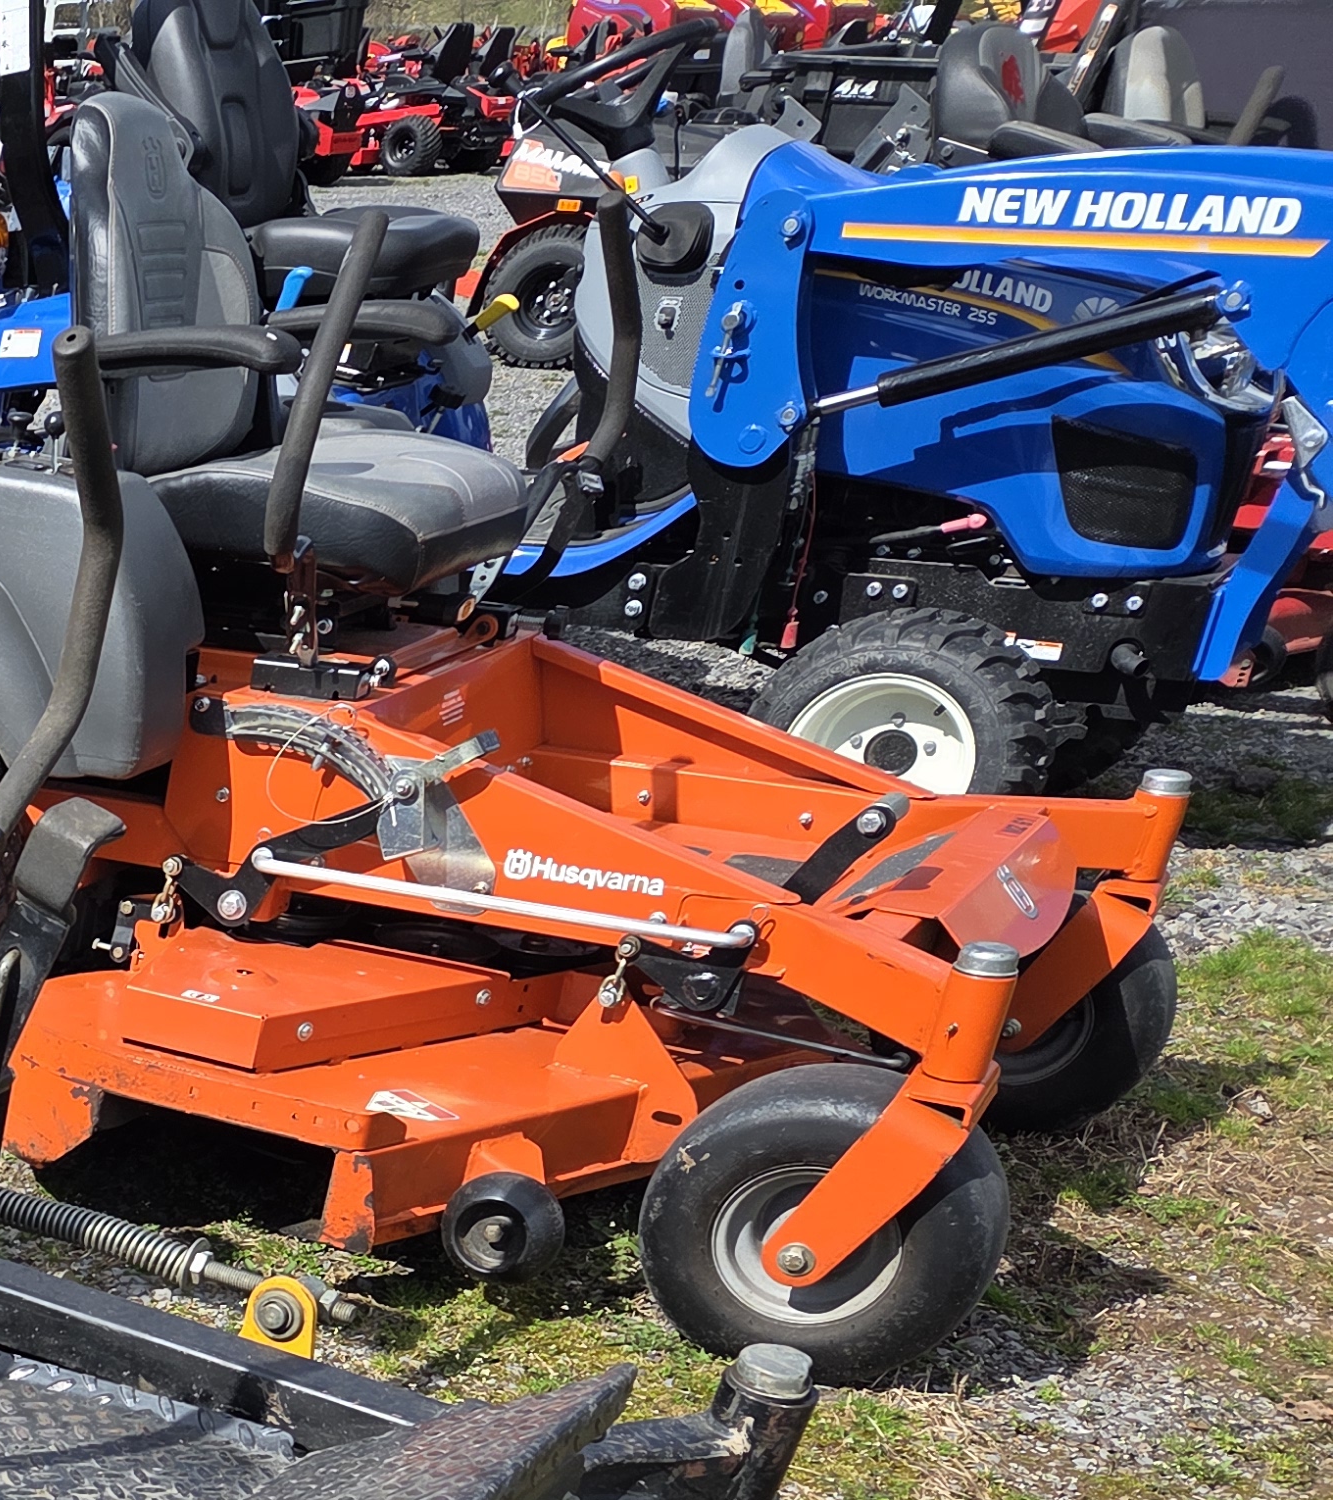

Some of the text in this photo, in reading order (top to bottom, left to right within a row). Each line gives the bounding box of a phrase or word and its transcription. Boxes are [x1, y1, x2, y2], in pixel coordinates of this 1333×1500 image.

[957, 186, 1303, 235] NEW HOLLAND
[859, 283, 998, 326] WORKMASTER 25S
[952, 270, 1053, 313] OLLAND
[531, 855, 664, 896] Husqvarna
